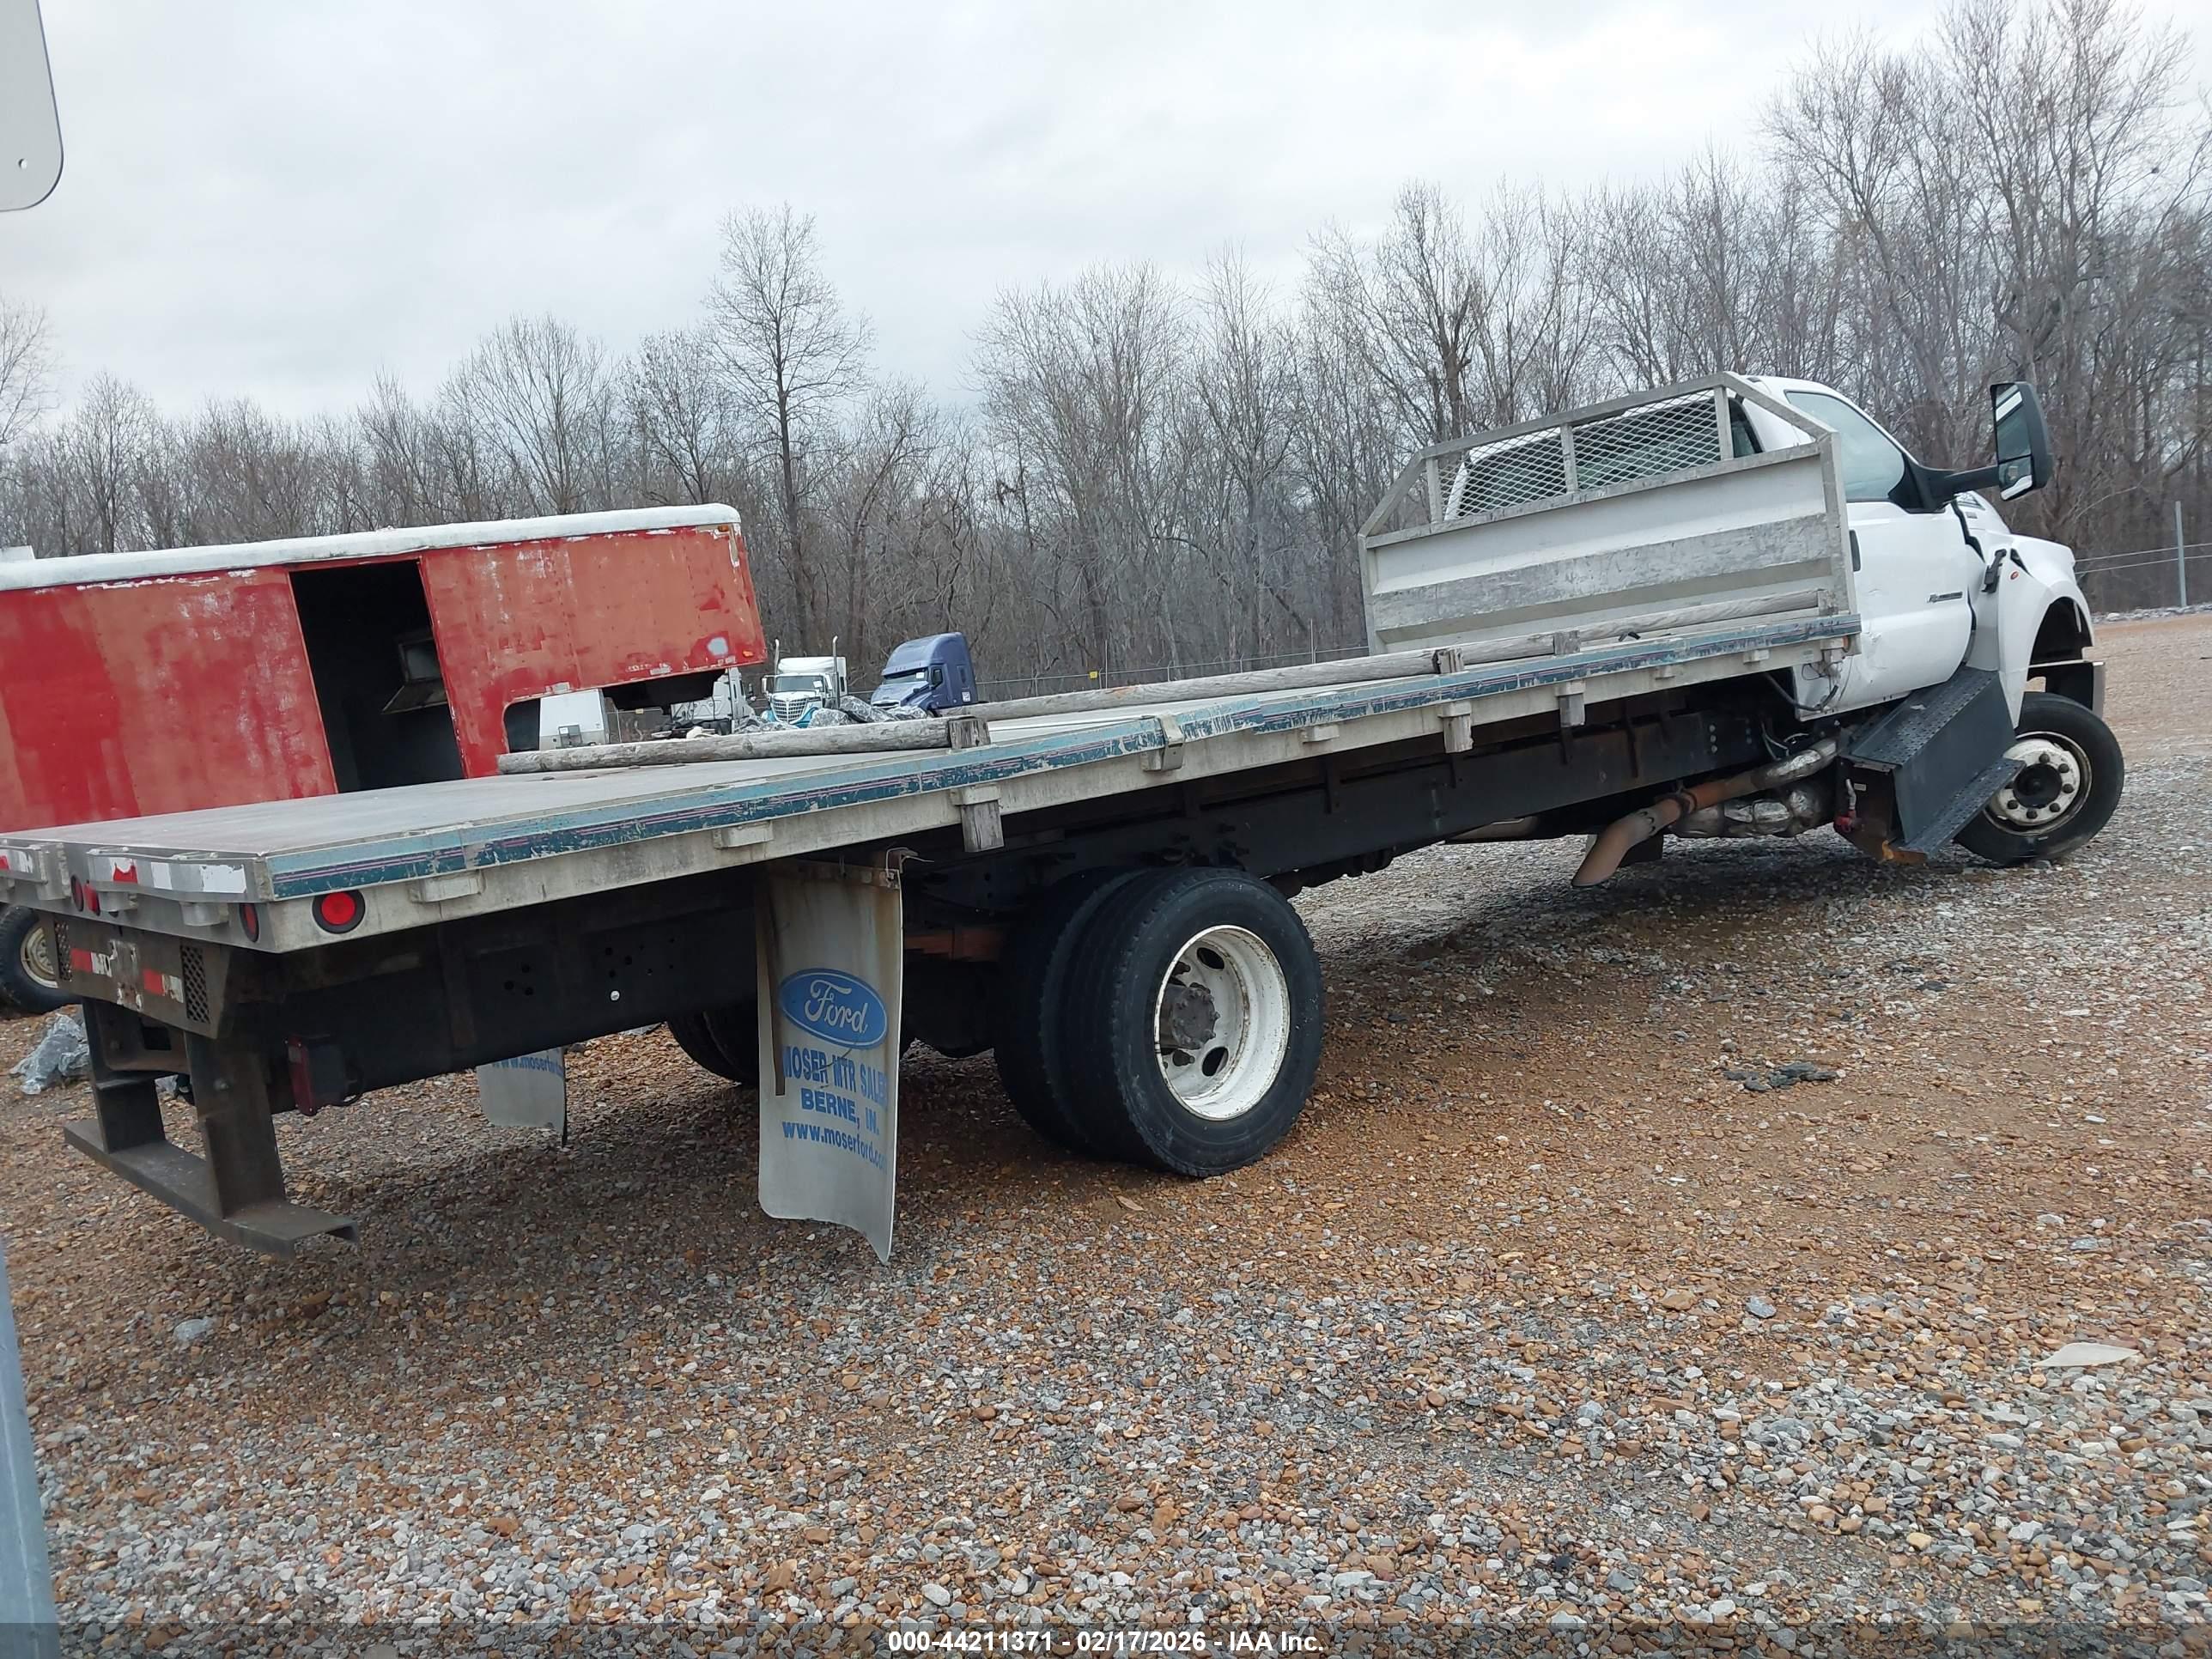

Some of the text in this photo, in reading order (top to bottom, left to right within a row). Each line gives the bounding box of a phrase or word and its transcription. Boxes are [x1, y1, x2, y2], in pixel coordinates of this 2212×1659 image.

[805, 980, 868, 1033] Ford
[783, 1046, 829, 1084] MOSER
[832, 1054, 856, 1092] MTR
[801, 1088, 879, 1135] BERNE, IN.
